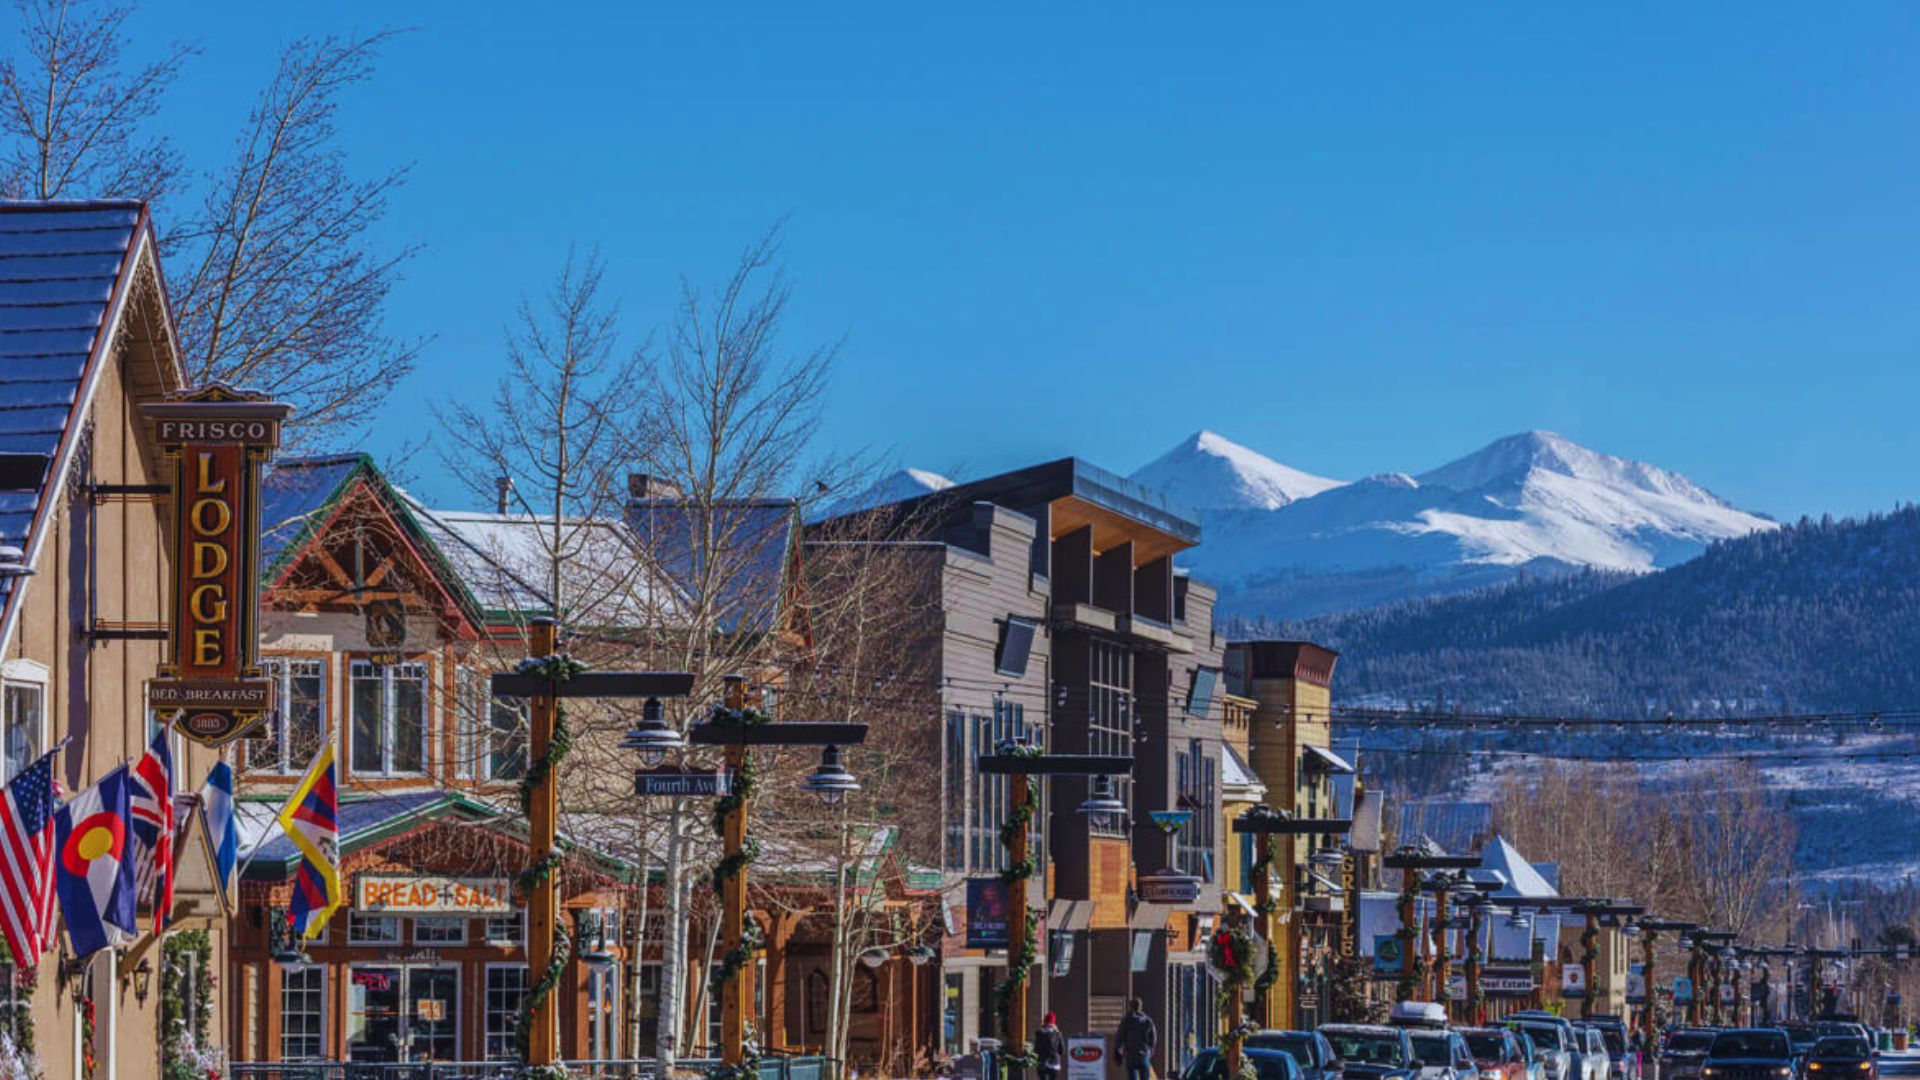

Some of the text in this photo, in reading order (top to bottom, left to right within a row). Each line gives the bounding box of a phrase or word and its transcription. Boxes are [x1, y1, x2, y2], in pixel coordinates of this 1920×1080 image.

[161, 422, 266, 439] FRISCO
[191, 452, 230, 667] LODGE
[151, 688, 177, 700] BED
[186, 689, 266, 700] BREAKFAST
[645, 777, 690, 793] Fourth
[364, 882, 437, 907] BREAD
[454, 884, 506, 907] SALT
[1502, 980, 1531, 989] Estate
